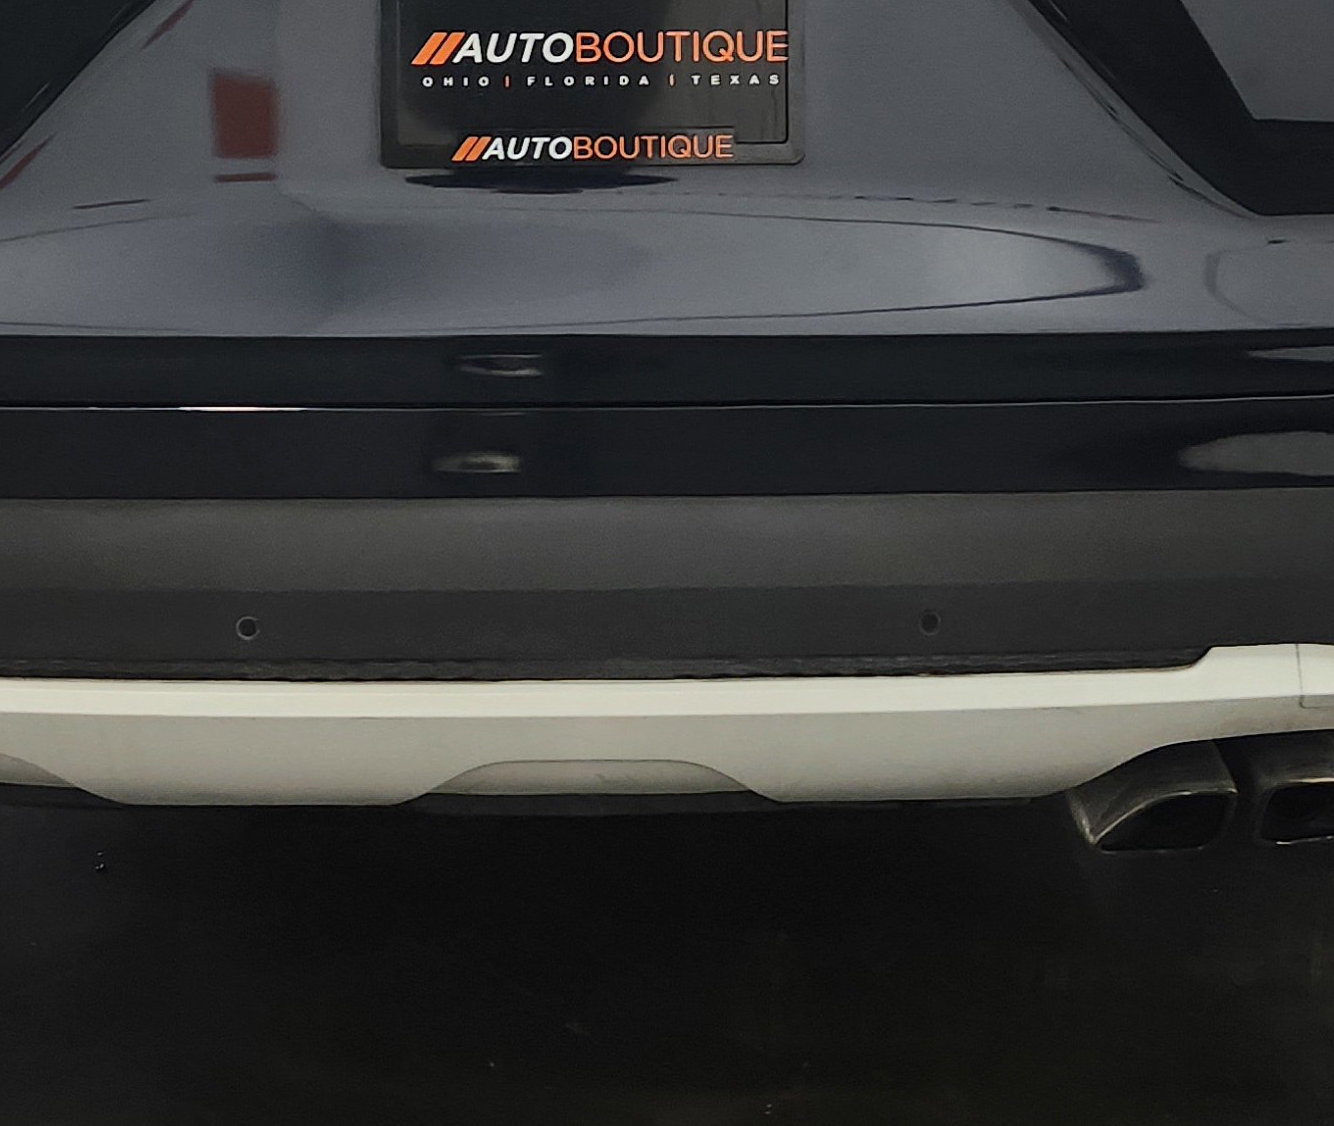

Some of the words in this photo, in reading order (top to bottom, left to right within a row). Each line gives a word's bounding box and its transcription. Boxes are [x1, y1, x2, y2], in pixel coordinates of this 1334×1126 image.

[451, 30, 789, 64] AUTOBOUTIQUE
[422, 75, 490, 88] OHIO
[526, 74, 650, 87] FLORIDA
[690, 73, 781, 86] TEXAS
[480, 134, 734, 161] AUTOBOUTIQUE
